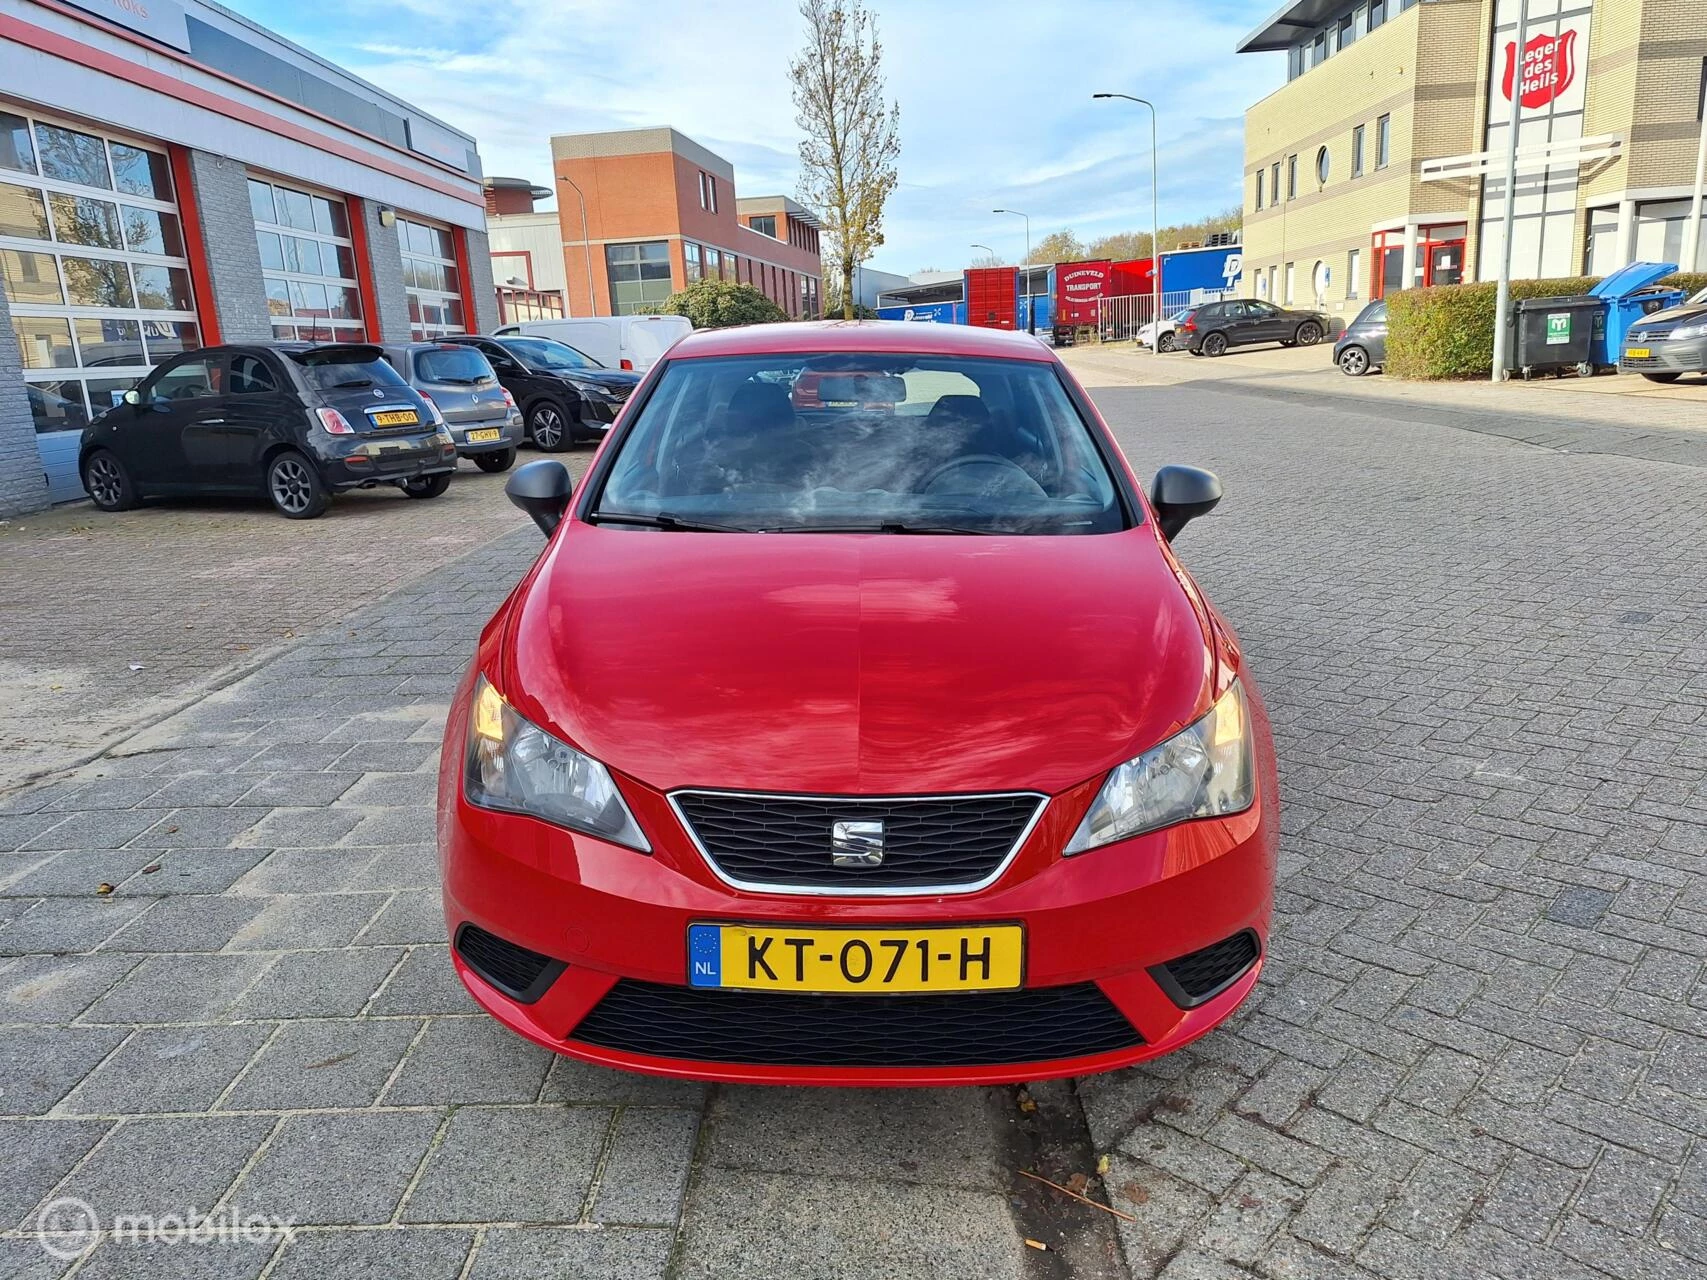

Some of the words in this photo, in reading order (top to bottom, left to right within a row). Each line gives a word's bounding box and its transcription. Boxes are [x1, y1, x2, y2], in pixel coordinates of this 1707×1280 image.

[1520, 39, 1562, 65] Leger
[1525, 59, 1552, 78] des
[1519, 73, 1558, 96] Heils
[1064, 270, 1104, 282] DUINEVELD
[1066, 282, 1101, 291] TRANSPORT
[695, 962, 716, 975] NL
[748, 937, 991, 984] KT-071-H
